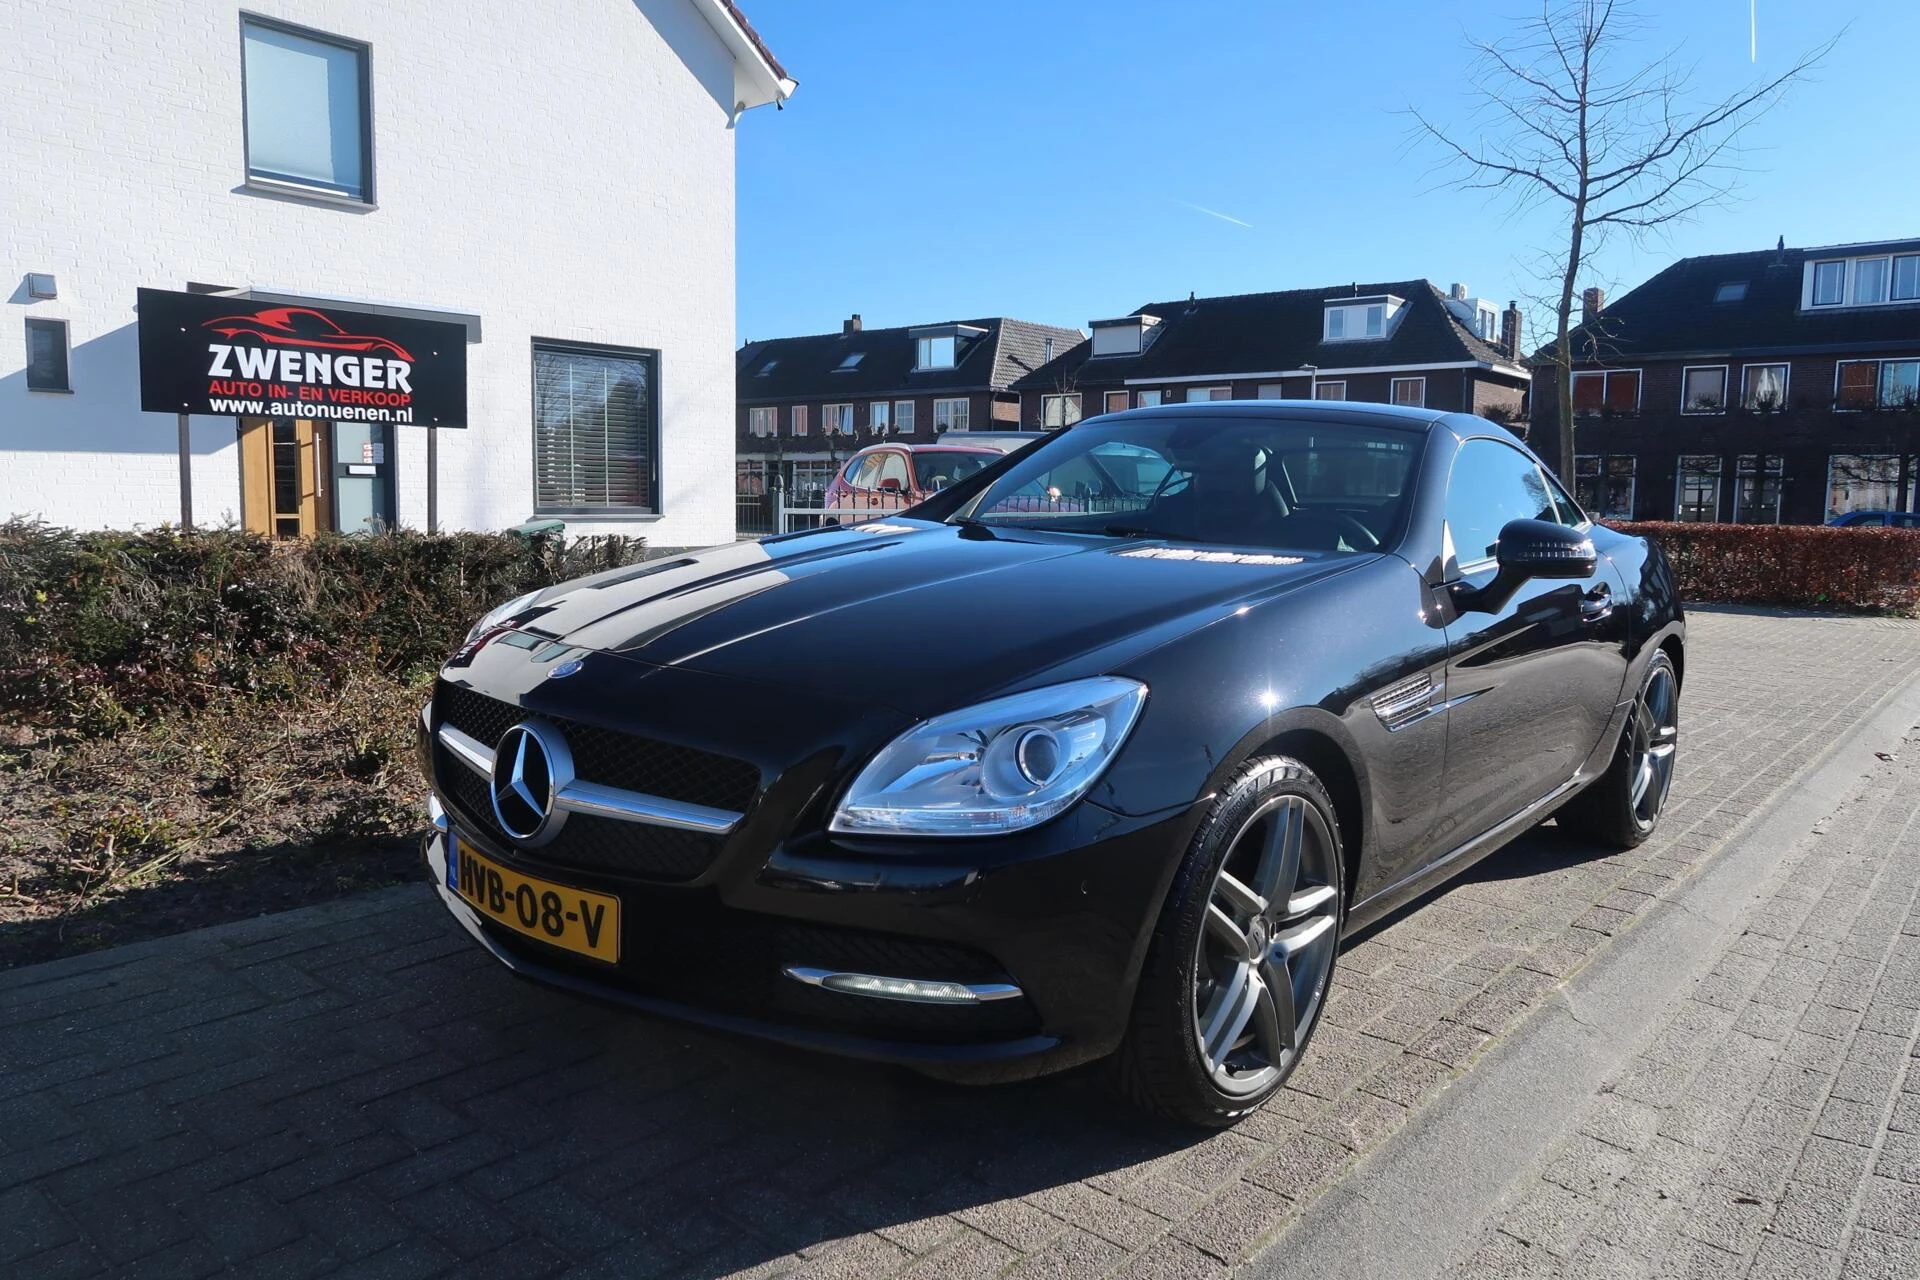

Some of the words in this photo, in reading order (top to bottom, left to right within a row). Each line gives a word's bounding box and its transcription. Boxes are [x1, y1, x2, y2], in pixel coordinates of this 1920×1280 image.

[208, 344, 413, 394] ZWENGER
[209, 380, 262, 398] AUTO
[268, 384, 294, 399] IN-
[300, 386, 323, 401] EN
[328, 388, 411, 407] VERKOOP
[209, 398, 413, 423] www.autonuenen.nl
[460, 850, 605, 948] HVB-08-V
